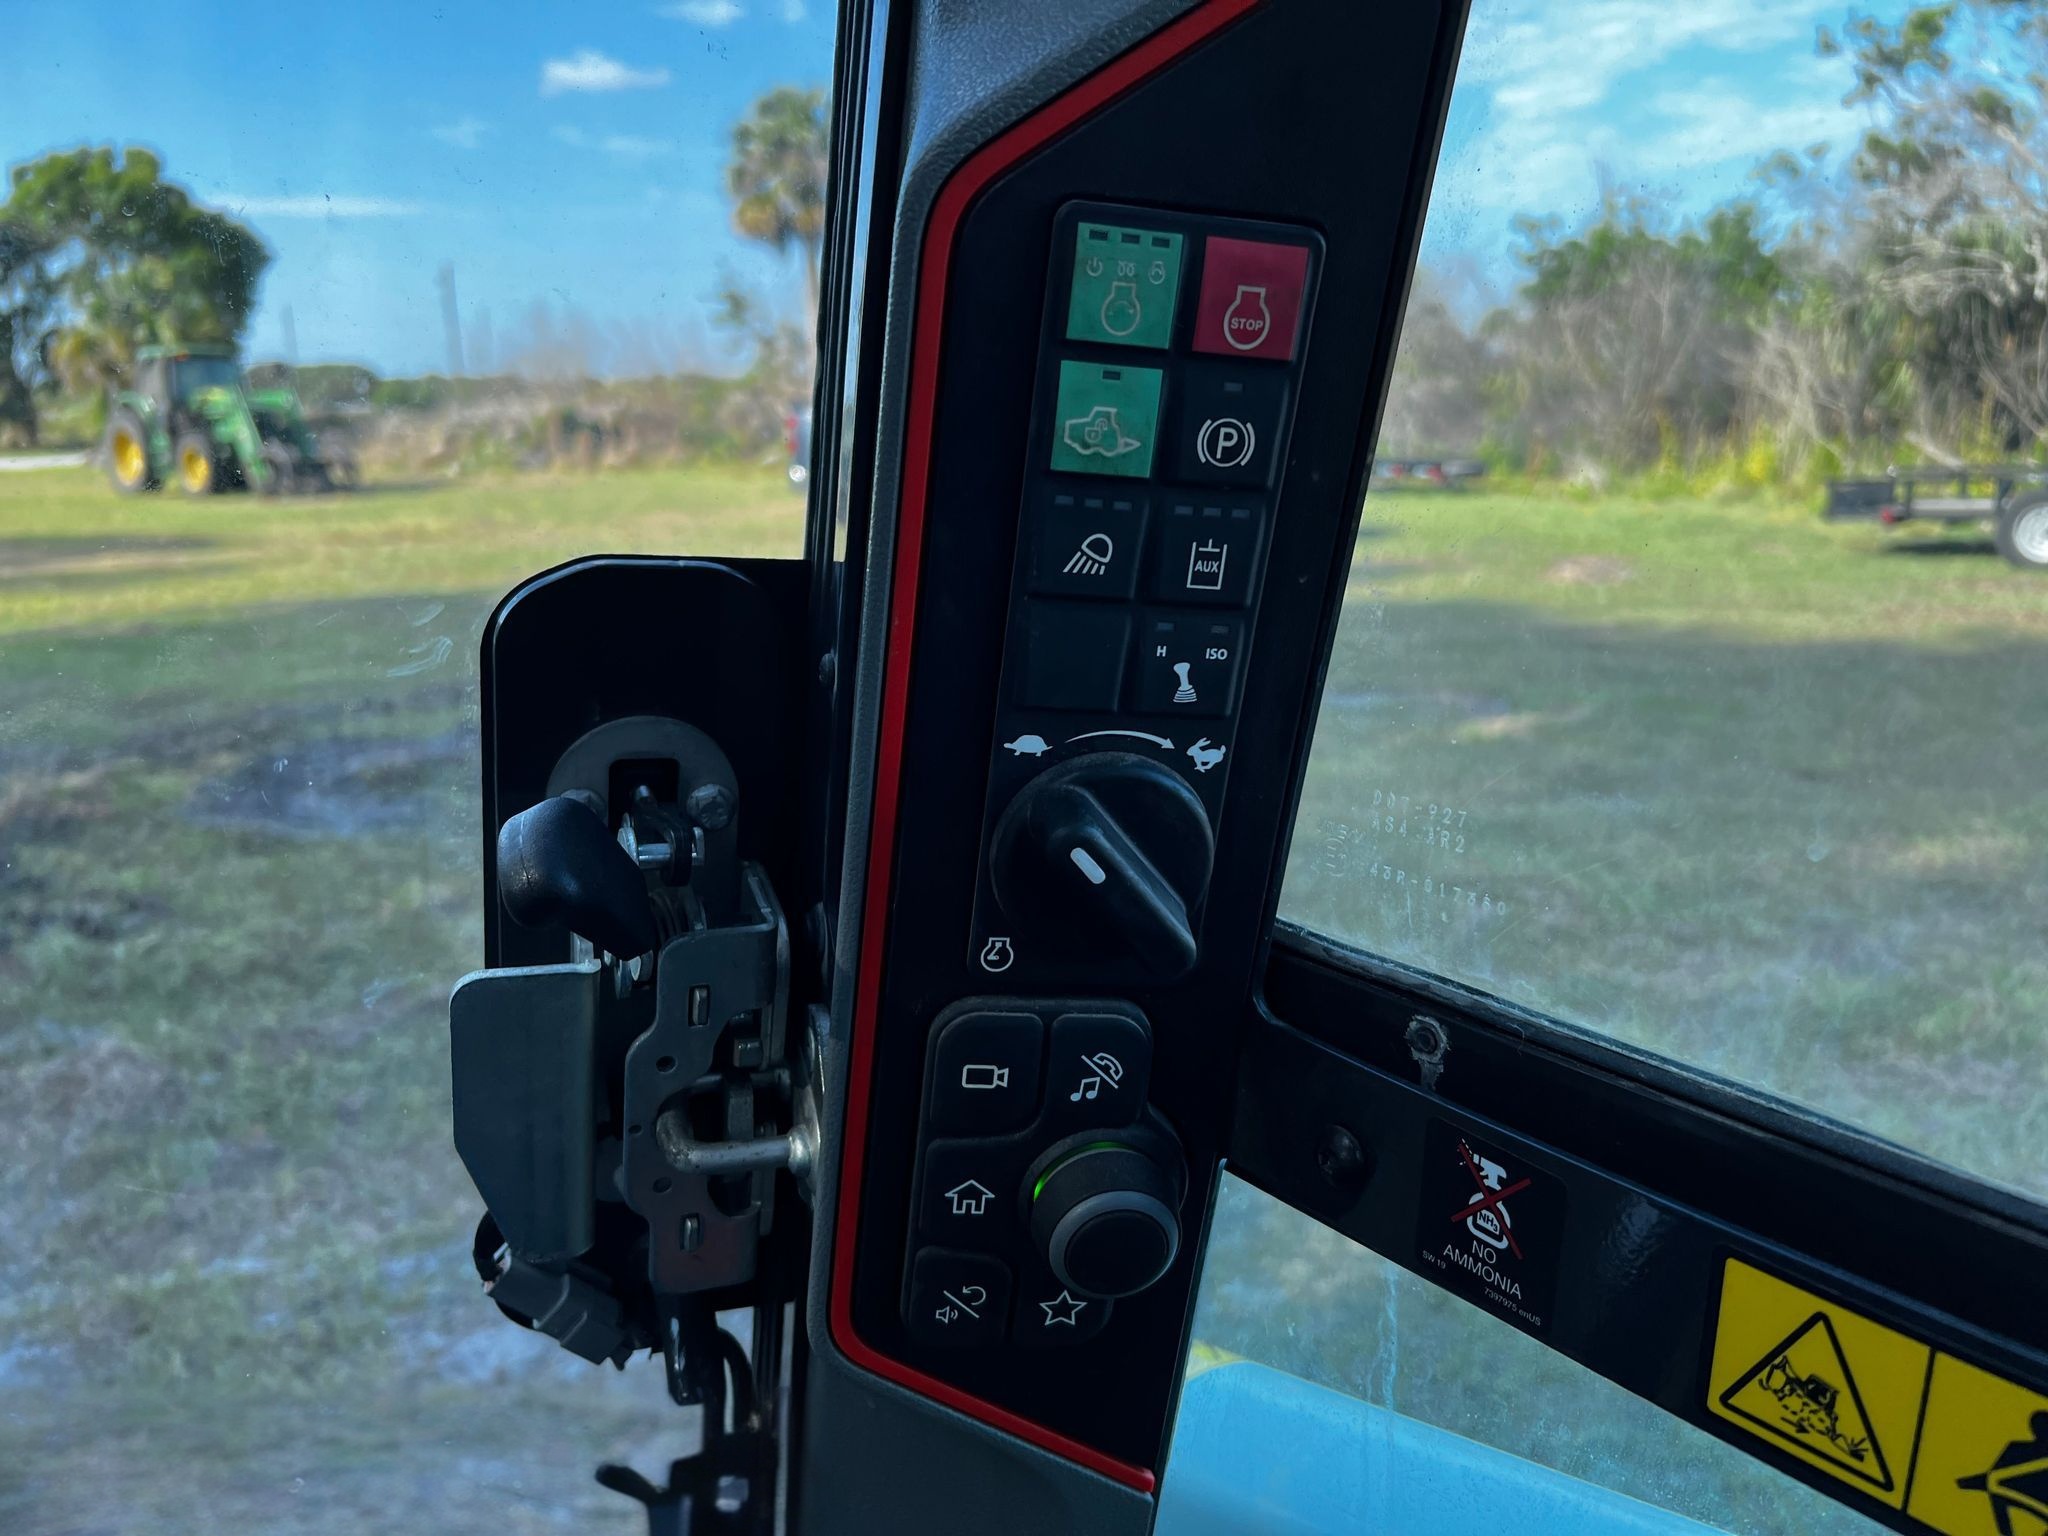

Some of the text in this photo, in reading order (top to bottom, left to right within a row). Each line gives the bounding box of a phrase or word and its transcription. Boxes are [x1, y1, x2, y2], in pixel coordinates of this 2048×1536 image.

[1230, 317, 1264, 331] STOP
[1216, 426, 1239, 459] P
[1194, 560, 1220, 573] AUX
[1156, 645, 1167, 657] H
[1205, 647, 1228, 660] ISO
[1422, 1249, 1447, 1270] SW 19
[1471, 1239, 1497, 1264] NO
[1442, 1243, 1522, 1300] AMMONIA
